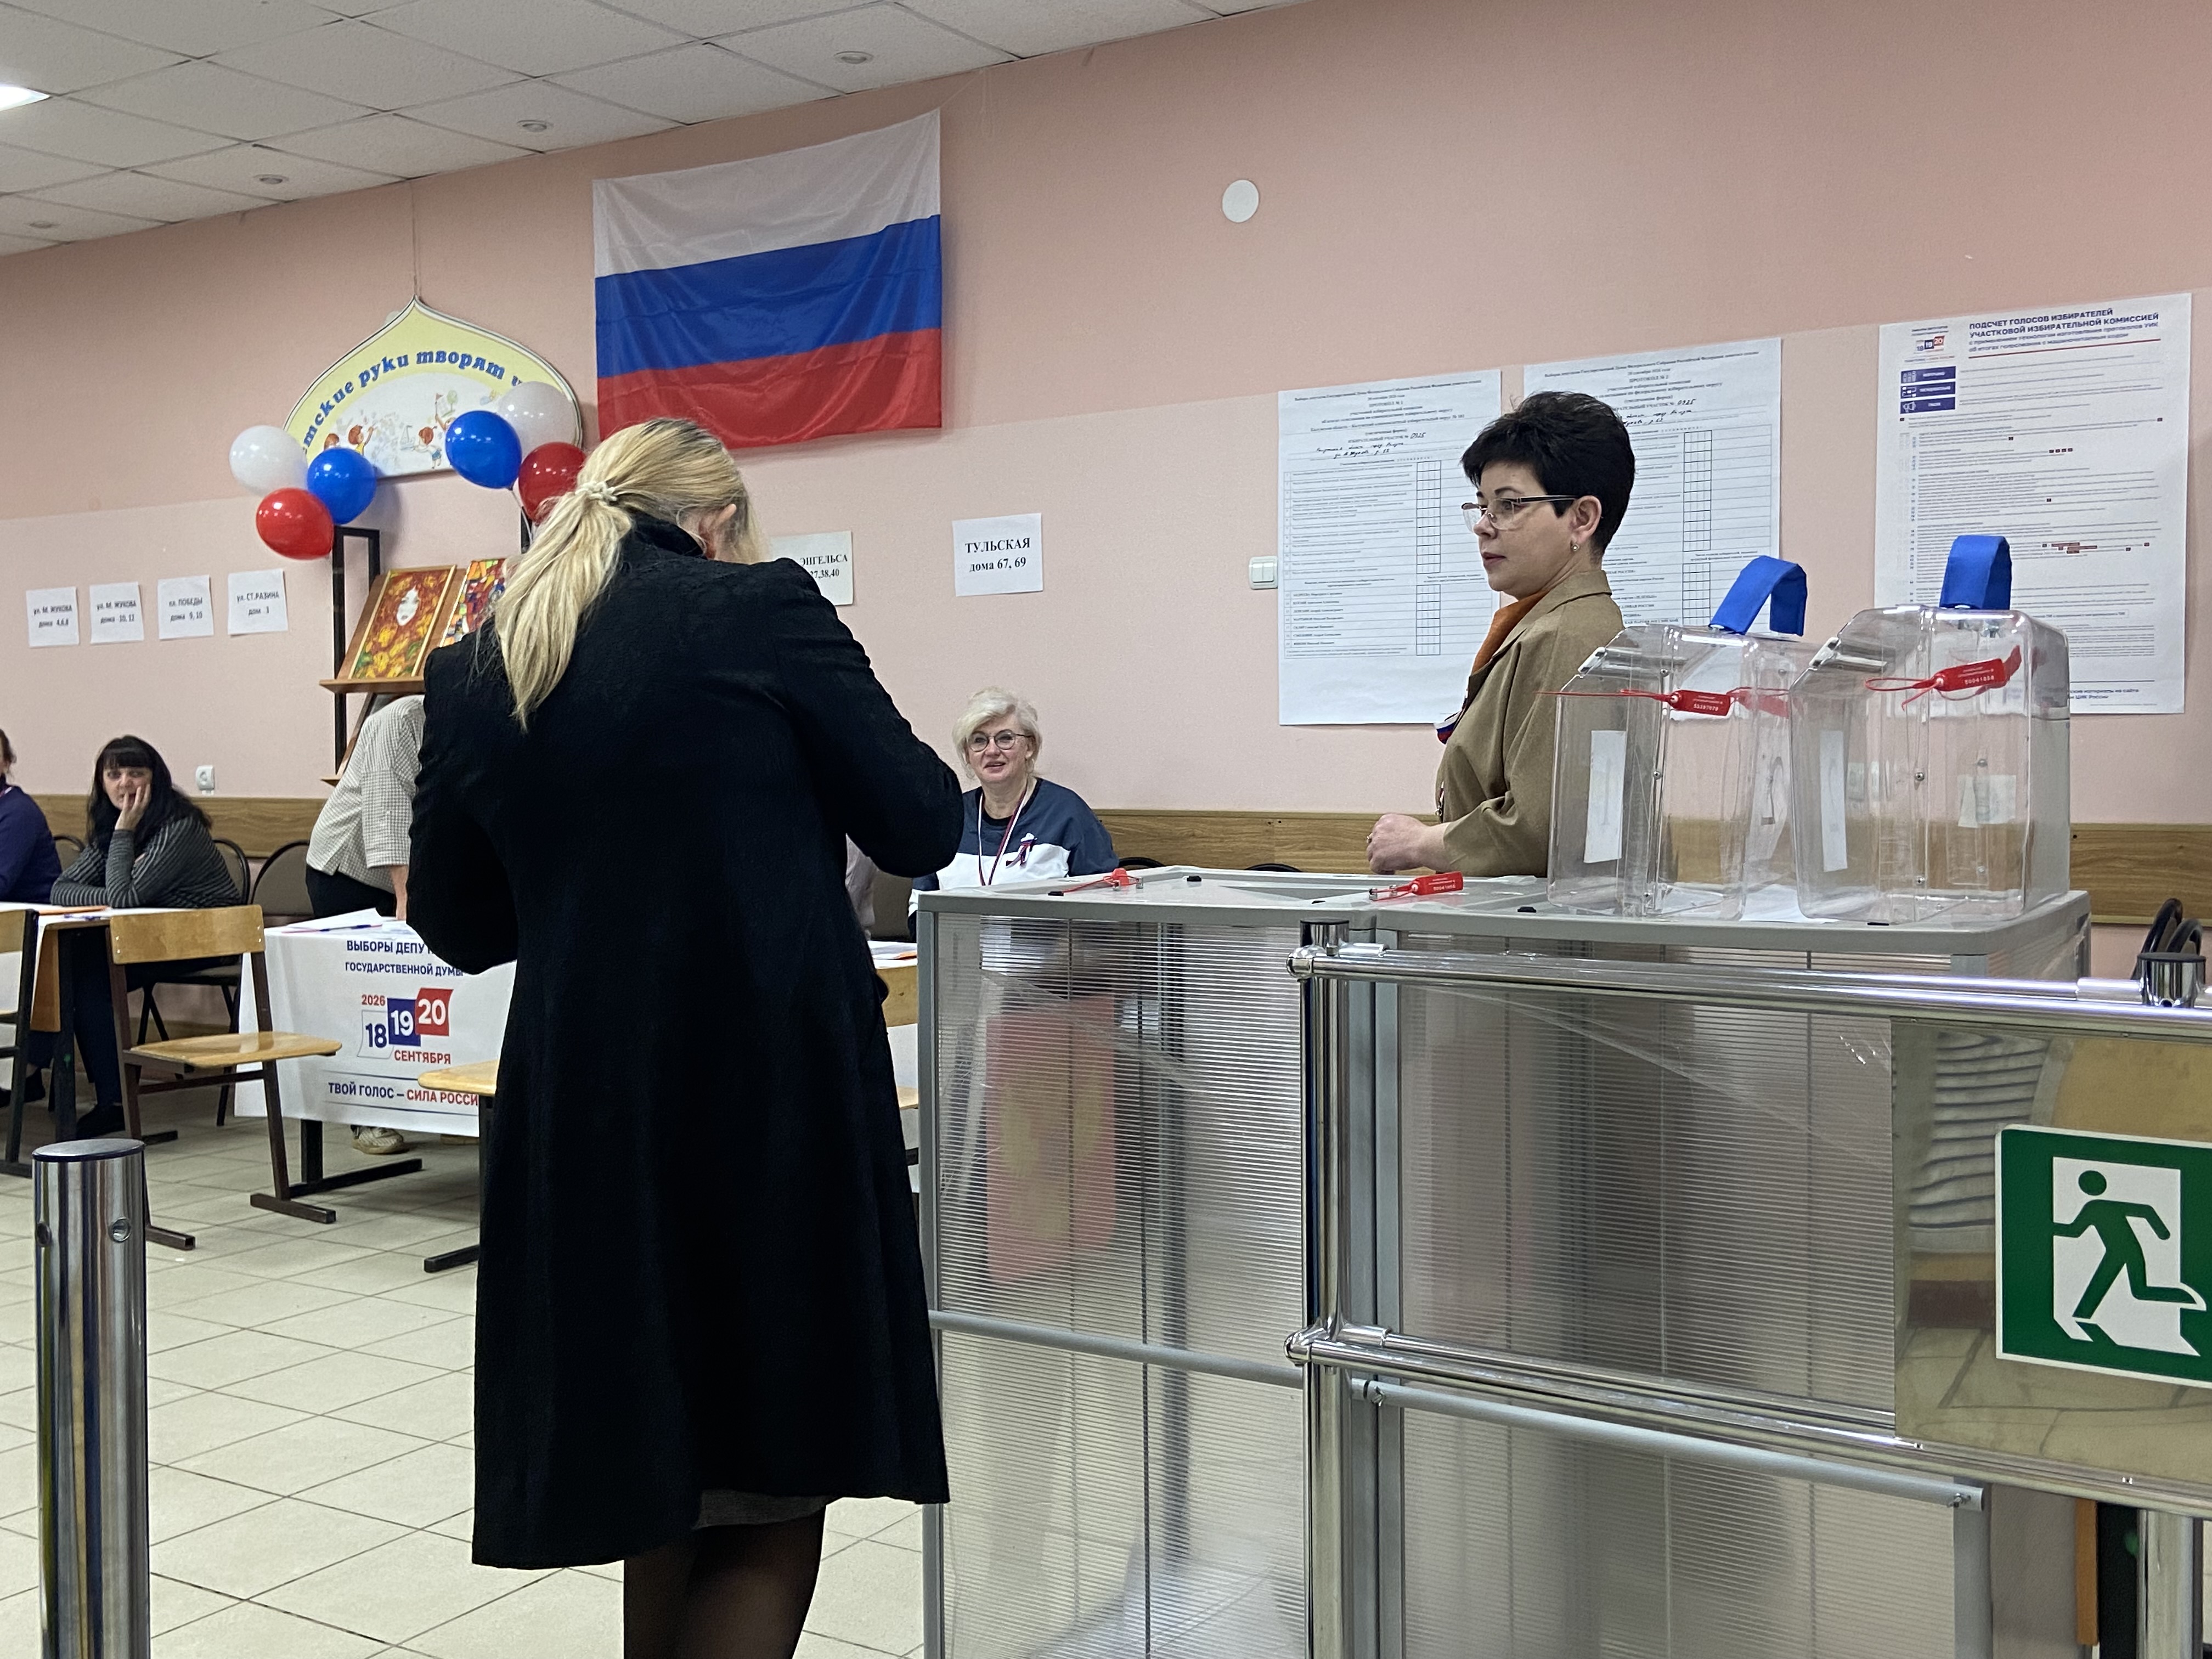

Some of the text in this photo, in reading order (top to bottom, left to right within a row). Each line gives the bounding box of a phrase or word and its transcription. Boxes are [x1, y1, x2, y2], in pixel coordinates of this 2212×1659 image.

[1970, 308, 2113, 330] ПОДСЧЕТ ГОЛОСОВ ИЗБИРАТЕЛЕЙ
[1970, 312, 2159, 338] УЧАСТКОВОЙ ИЗБИРАТЕЛЬНОЙ КОМИССИЕЙ
[358, 354, 409, 387] руки
[416, 350, 505, 380] творят
[965, 538, 1030, 553] ТУЛЬСКАЯ
[800, 554, 848, 566] ЭНГЕЛЬСА
[969, 557, 1026, 572] дома 67, 69
[178, 597, 202, 606] ПОБЕДЫ
[347, 940, 433, 955] ВЫБОРЫ ДЕПУ
[345, 962, 433, 975] ГОСУДАРСТВЕННОЙ
[361, 994, 386, 1006] 2026
[365, 998, 447, 1048] 18 19 20
[394, 1049, 451, 1064] СЕНТЯБРЯ
[329, 1081, 356, 1096] ТВОЙ
[359, 1085, 394, 1098] ГОЛОС
[407, 1089, 438, 1103] СИЛА
[439, 1092, 478, 1106] РОССИ
